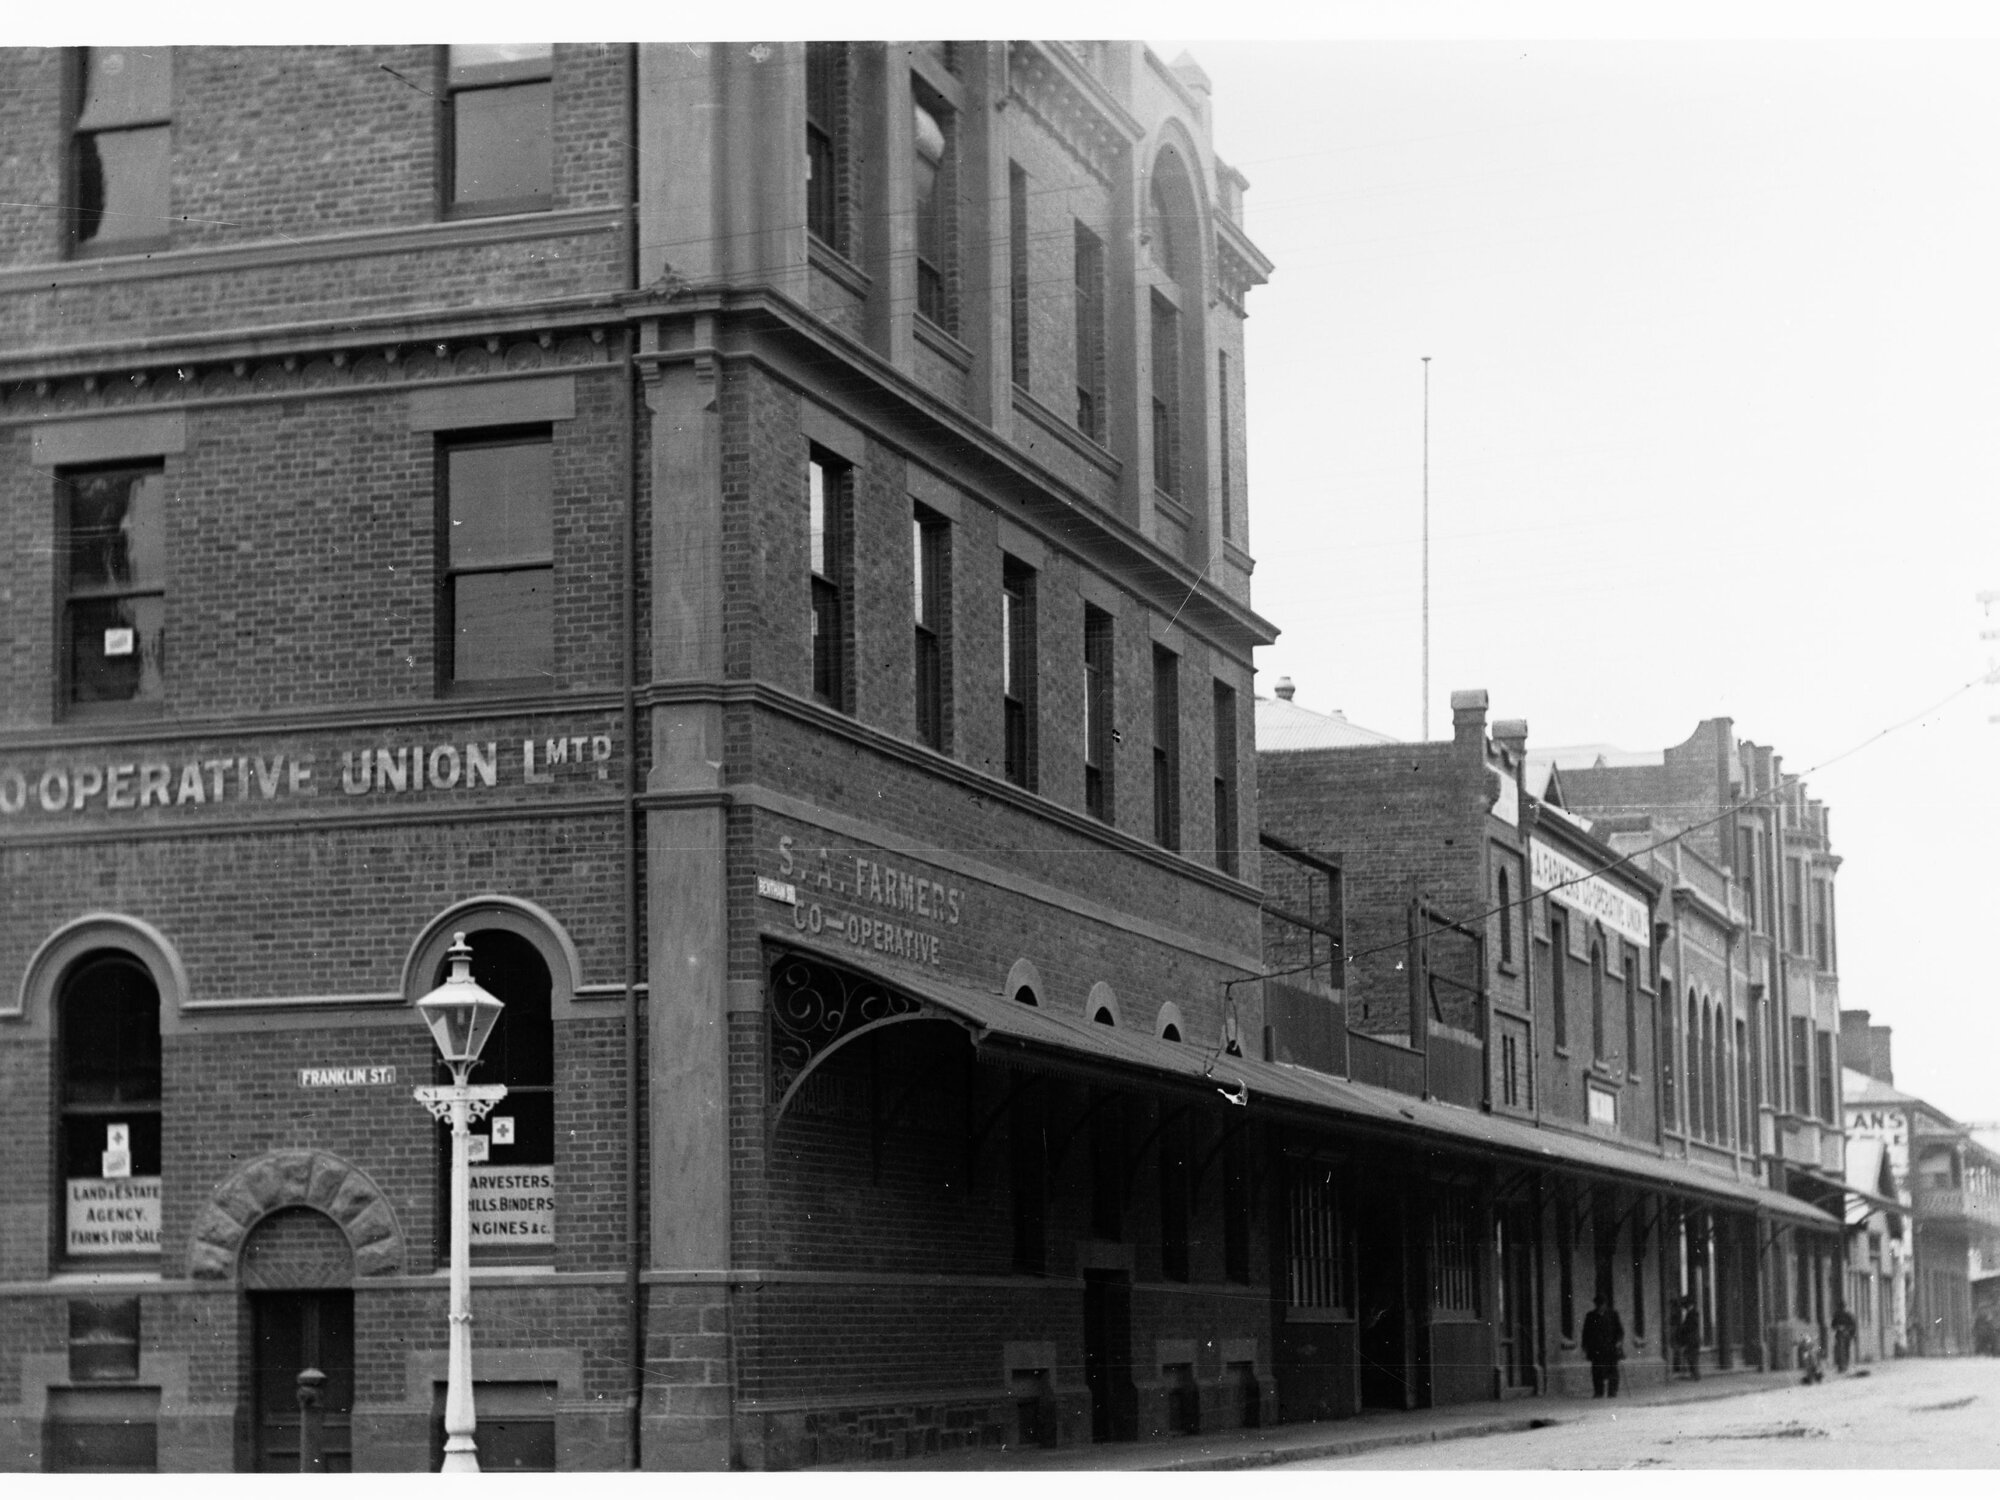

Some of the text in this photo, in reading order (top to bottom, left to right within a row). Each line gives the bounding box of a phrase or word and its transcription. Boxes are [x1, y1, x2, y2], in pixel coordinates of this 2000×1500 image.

[342, 742, 498, 796] UNION
[793, 900, 940, 964] CO-OPERATIVE
[302, 1067, 366, 1085] FRANKLIN
[72, 1186, 107, 1201] LAND
[115, 1184, 160, 1199] ESTATE
[71, 1230, 109, 1244] FARMS
[111, 1229, 133, 1244] FOR
